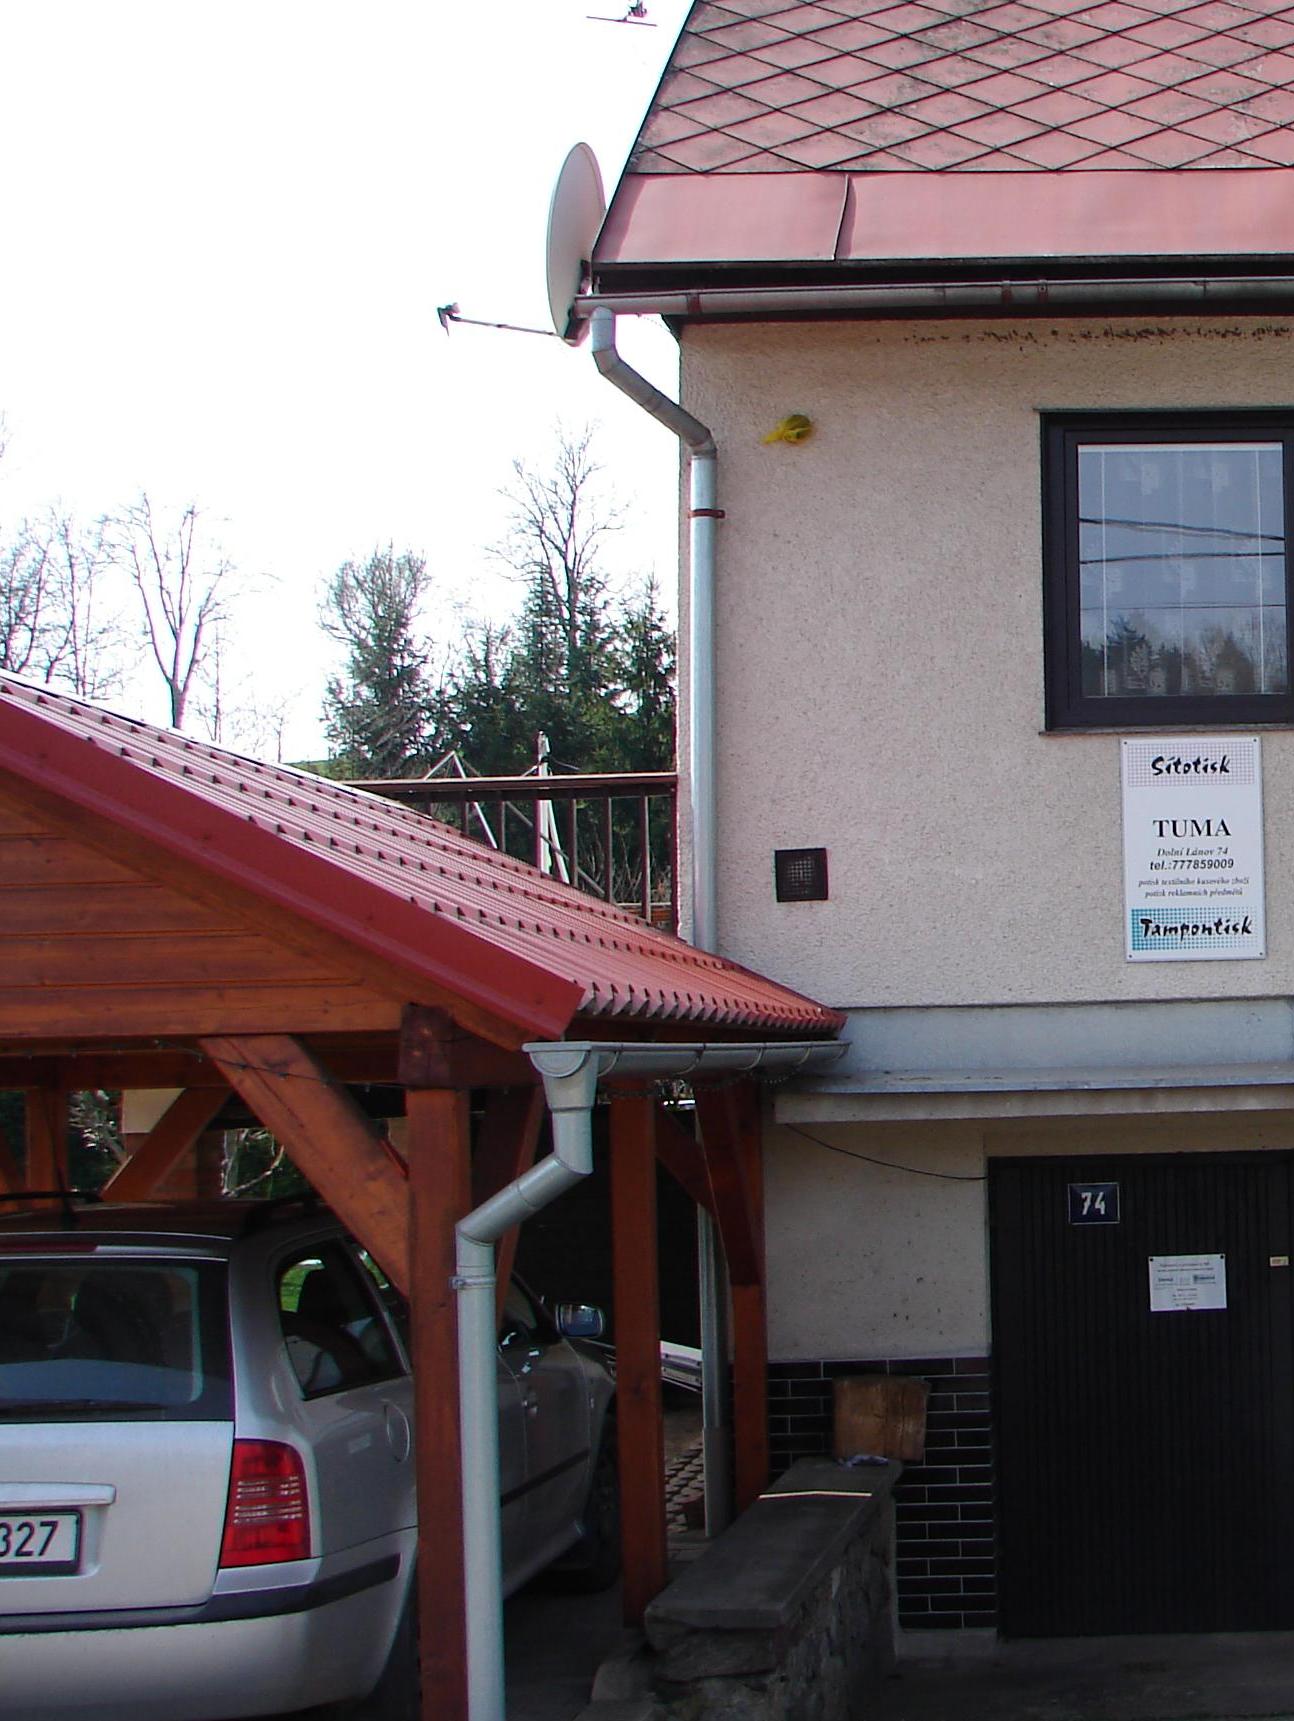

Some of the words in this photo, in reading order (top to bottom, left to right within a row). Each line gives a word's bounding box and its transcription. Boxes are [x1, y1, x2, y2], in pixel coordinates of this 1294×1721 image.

[1151, 755, 1231, 776] Sítotisk
[1152, 818, 1232, 838] TUMA
[1157, 847, 1184, 857] Dolní
[1217, 847, 1229, 855] 74
[1150, 858, 1234, 870] tel.:777859009
[1140, 916, 1252, 941] Tampontisk
[1081, 1192, 1106, 1215] 74
